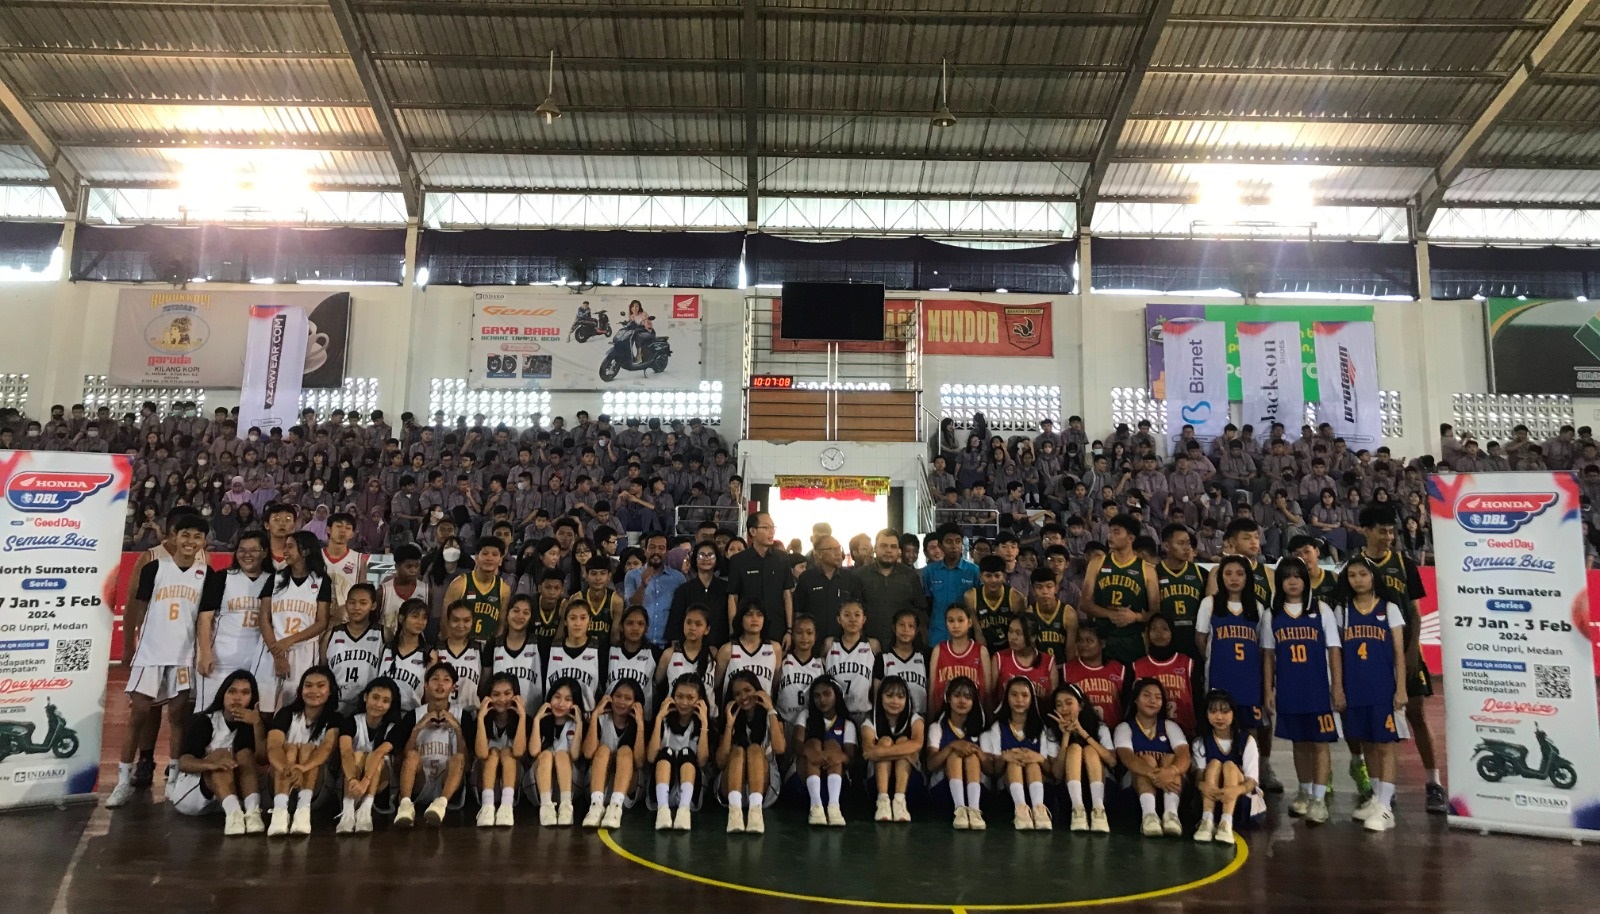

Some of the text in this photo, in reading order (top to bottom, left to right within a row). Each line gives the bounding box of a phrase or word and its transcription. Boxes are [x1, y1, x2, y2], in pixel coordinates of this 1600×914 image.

[482, 326, 560, 336] GAYA BARU
[928, 310, 999, 344] MUNDUR
[148, 355, 192, 366] garuda
[266, 318, 284, 405] AZAWEAR.COM
[1188, 338, 1204, 394] Biznet
[754, 378, 790, 386] 10:07:08
[1260, 340, 1278, 425] Jackson
[36, 480, 88, 488] HONDA
[32, 493, 59, 504] DBL
[1482, 514, 1508, 525] DBL
[3, 533, 98, 552] Semua Bisa
[35, 566, 98, 574] Sumatera
[1462, 554, 1556, 572] Semua Bisa
[1098, 575, 1141, 596] WAHIDIN
[1457, 585, 1562, 597] North Sumatera
[155, 584, 199, 603] WAHIDIN
[1111, 590, 1123, 605] 12
[9, 597, 39, 608] Jan
[56, 596, 66, 607] 3
[71, 595, 102, 607] Feb
[227, 597, 260, 612] WAHI
[271, 599, 317, 618] WAHIDIN
[1175, 601, 1186, 615] 15
[1494, 602, 1524, 610] Series
[28, 611, 56, 619] 2024
[168, 603, 180, 620] 6
[474, 602, 500, 621] HIDIN
[19, 623, 50, 632] Unpri,
[53, 622, 88, 630] Medan
[242, 611, 259, 628] 15
[284, 617, 301, 634] 12
[475, 619, 482, 633] 6
[1454, 616, 1473, 627] 27
[1478, 617, 1508, 629] Jan
[1524, 619, 1534, 630] 3
[1540, 620, 1572, 632] Feb
[1216, 625, 1257, 641] WAHIDIN
[1274, 626, 1318, 642] WAHIDIN
[1499, 632, 1527, 641] 2024
[1235, 643, 1245, 660] 5
[1290, 644, 1307, 663] 10
[1357, 642, 1367, 660] 4
[1467, 643, 1563, 656] GOR Unpri, Medan
[330, 650, 379, 670] WAHIDIN
[178, 668, 188, 684] 6
[345, 667, 359, 682] 14
[506, 666, 538, 684] HIDIN
[827, 662, 872, 680] WAHIDIN
[780, 673, 814, 690] WAHID
[844, 680, 852, 695] 7
[1463, 678, 1527, 688] mendapatkan
[1463, 684, 1519, 694] kesempatan
[798, 690, 805, 705] 6
[1253, 706, 1262, 720] 5
[1318, 713, 1335, 732] 10
[1385, 715, 1395, 732] 4
[27, 769, 66, 778] INDAKO
[1528, 796, 1568, 806] INDAKO
